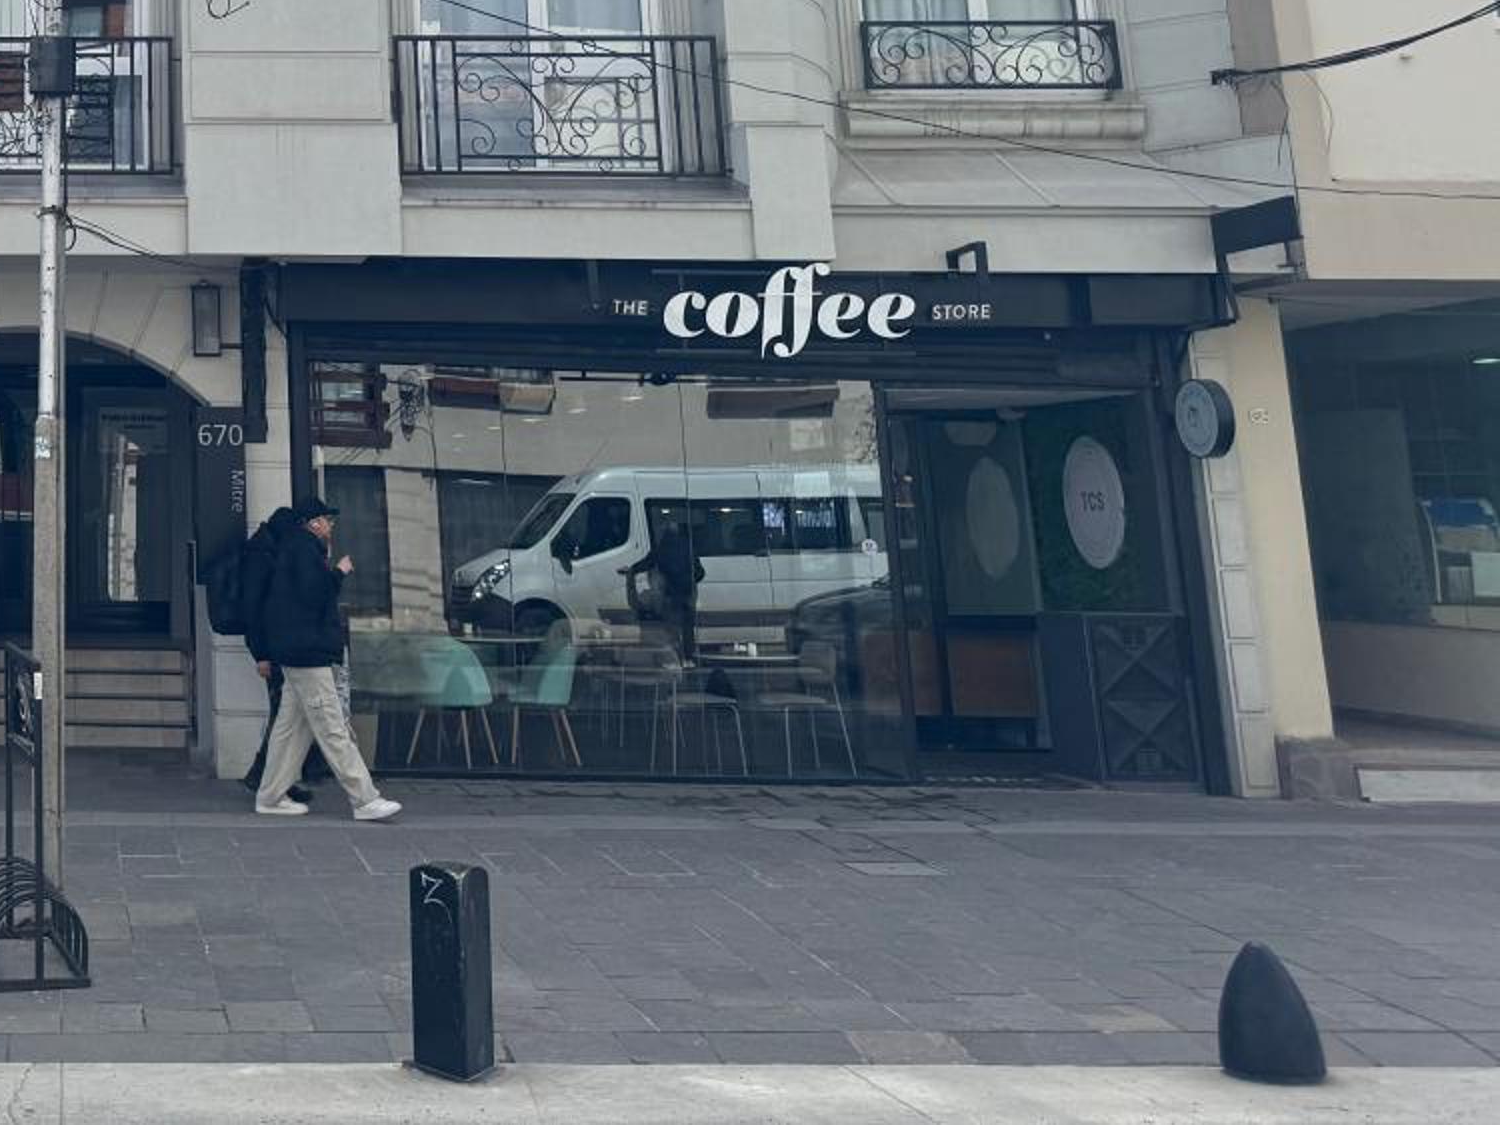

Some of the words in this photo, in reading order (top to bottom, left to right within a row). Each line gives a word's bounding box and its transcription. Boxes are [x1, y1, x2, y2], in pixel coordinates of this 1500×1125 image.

[612, 298, 649, 317] THE
[662, 261, 917, 360] coffee
[932, 303, 992, 321] STORE
[197, 423, 244, 447] 670
[231, 468, 245, 514] Mitre
[1080, 490, 1105, 512] TCS
